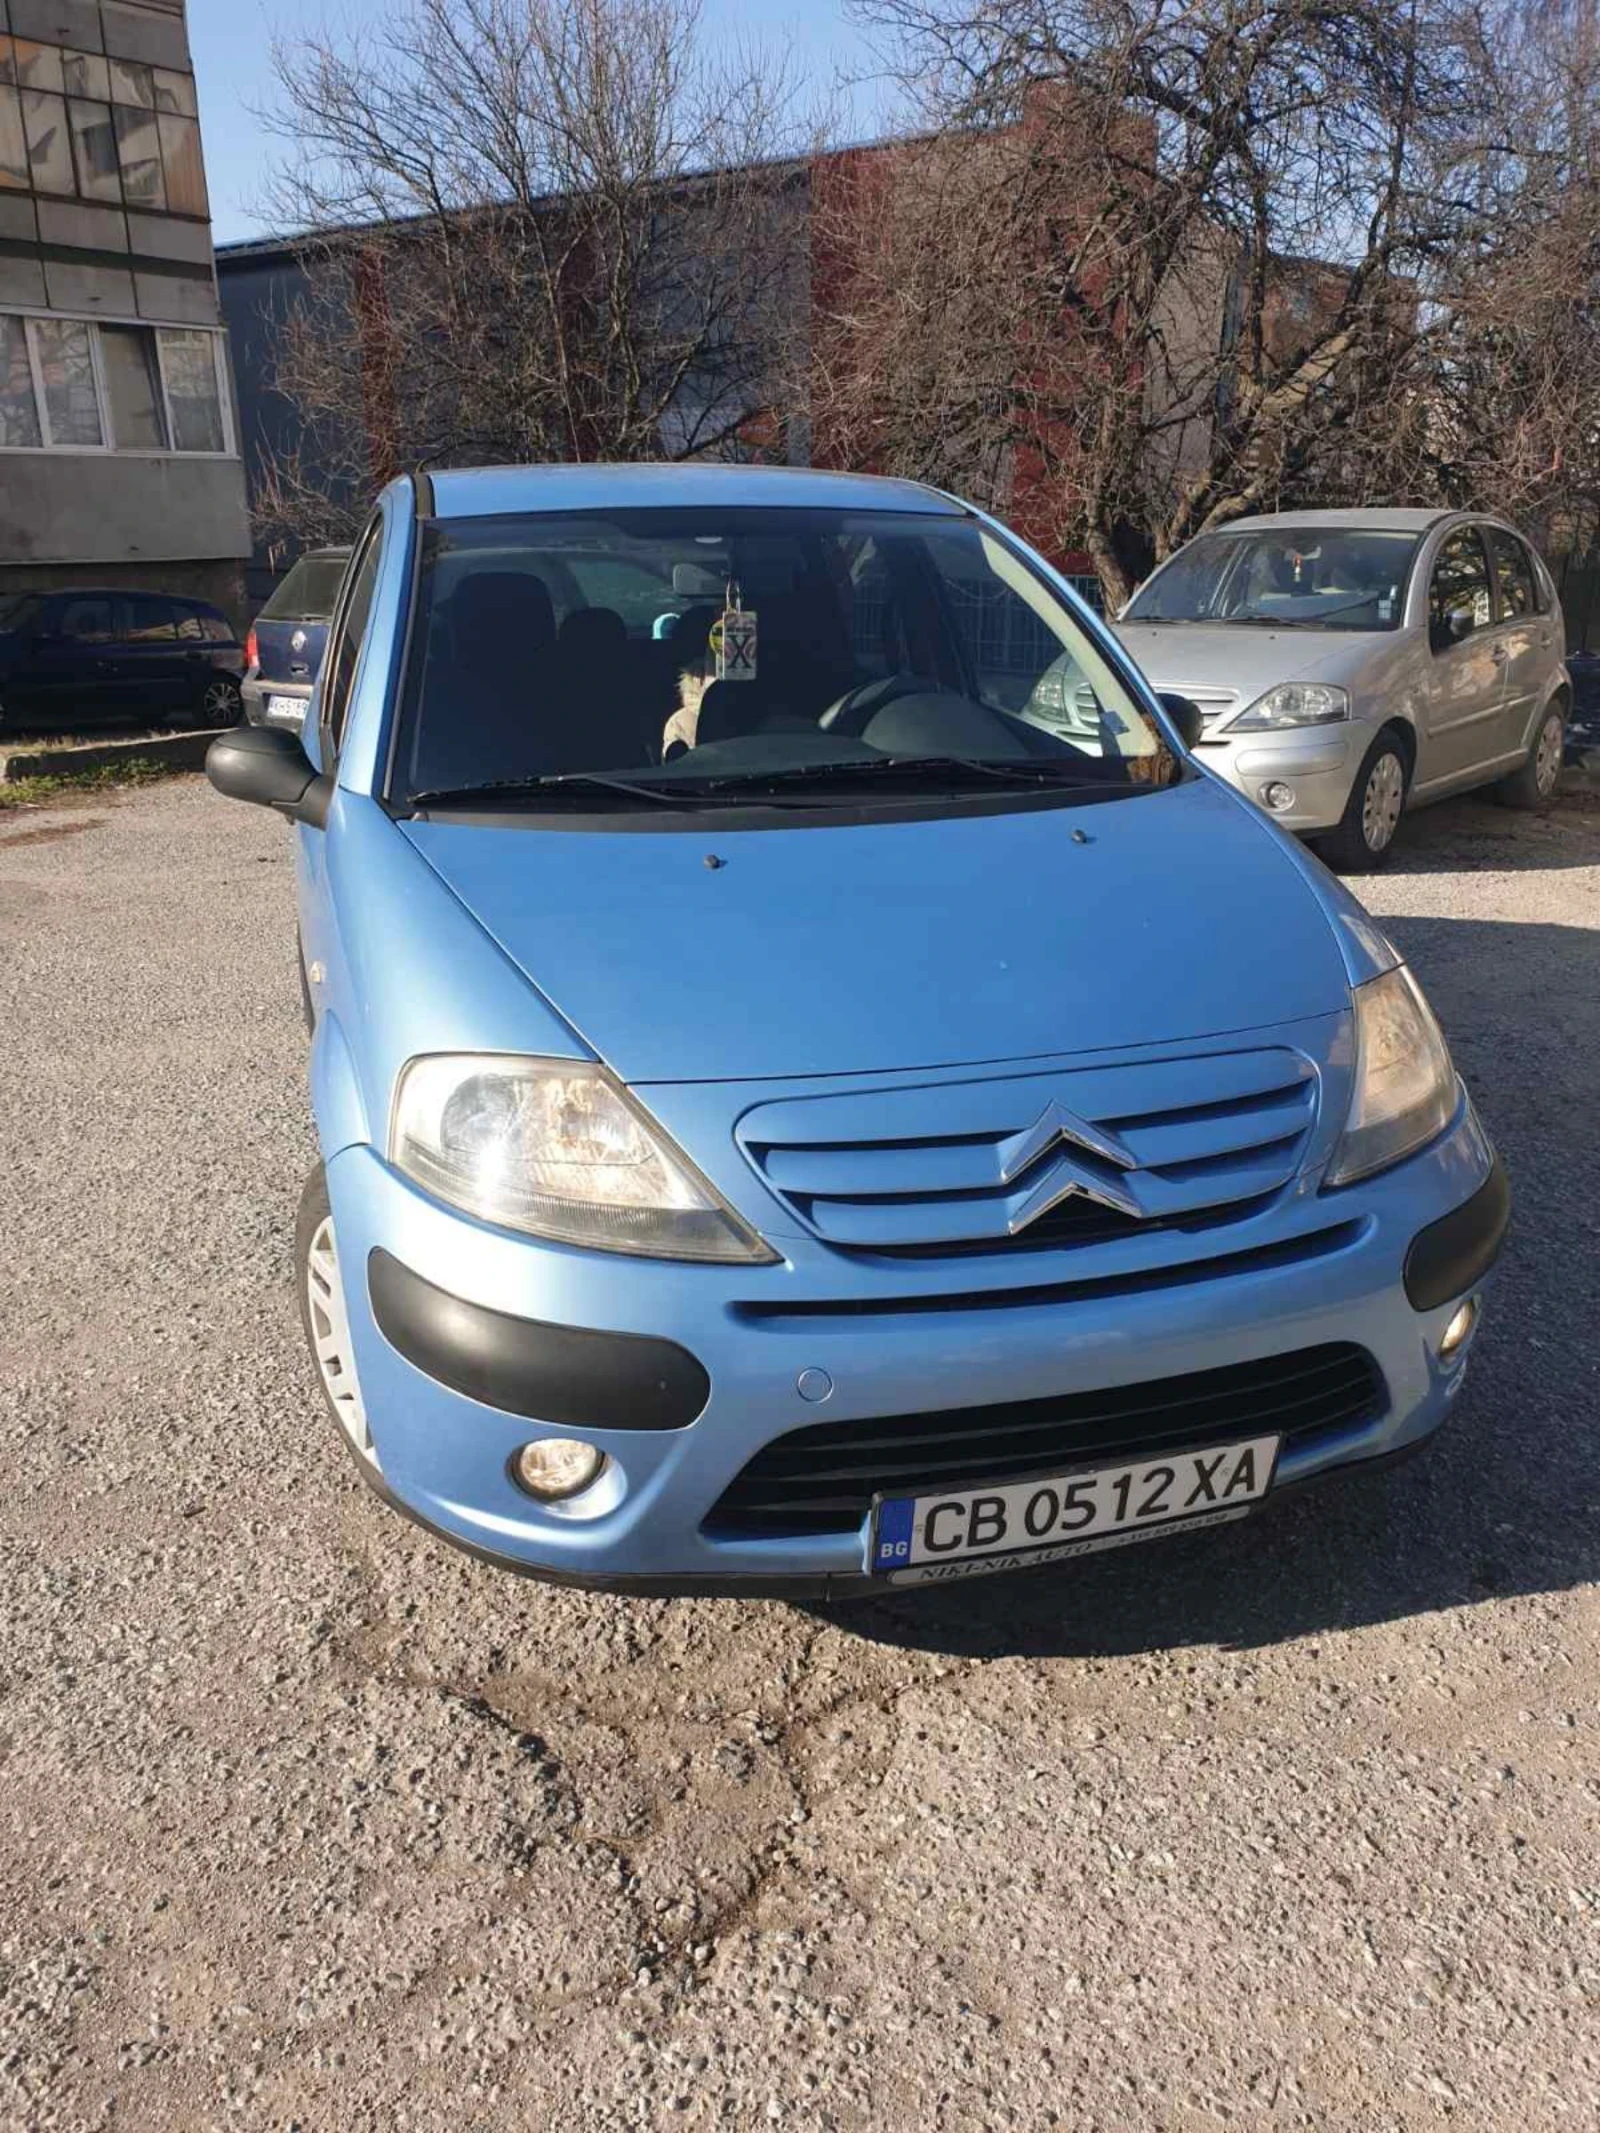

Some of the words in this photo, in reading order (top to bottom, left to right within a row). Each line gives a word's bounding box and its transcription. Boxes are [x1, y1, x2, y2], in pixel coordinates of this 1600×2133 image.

[923, 1496, 1007, 1553] CB
[1024, 1466, 1175, 1537] 0512
[1183, 1448, 1255, 1507] XA
[881, 1541, 908, 1558] BG
[919, 1556, 1022, 1580] NIKI-NIK
